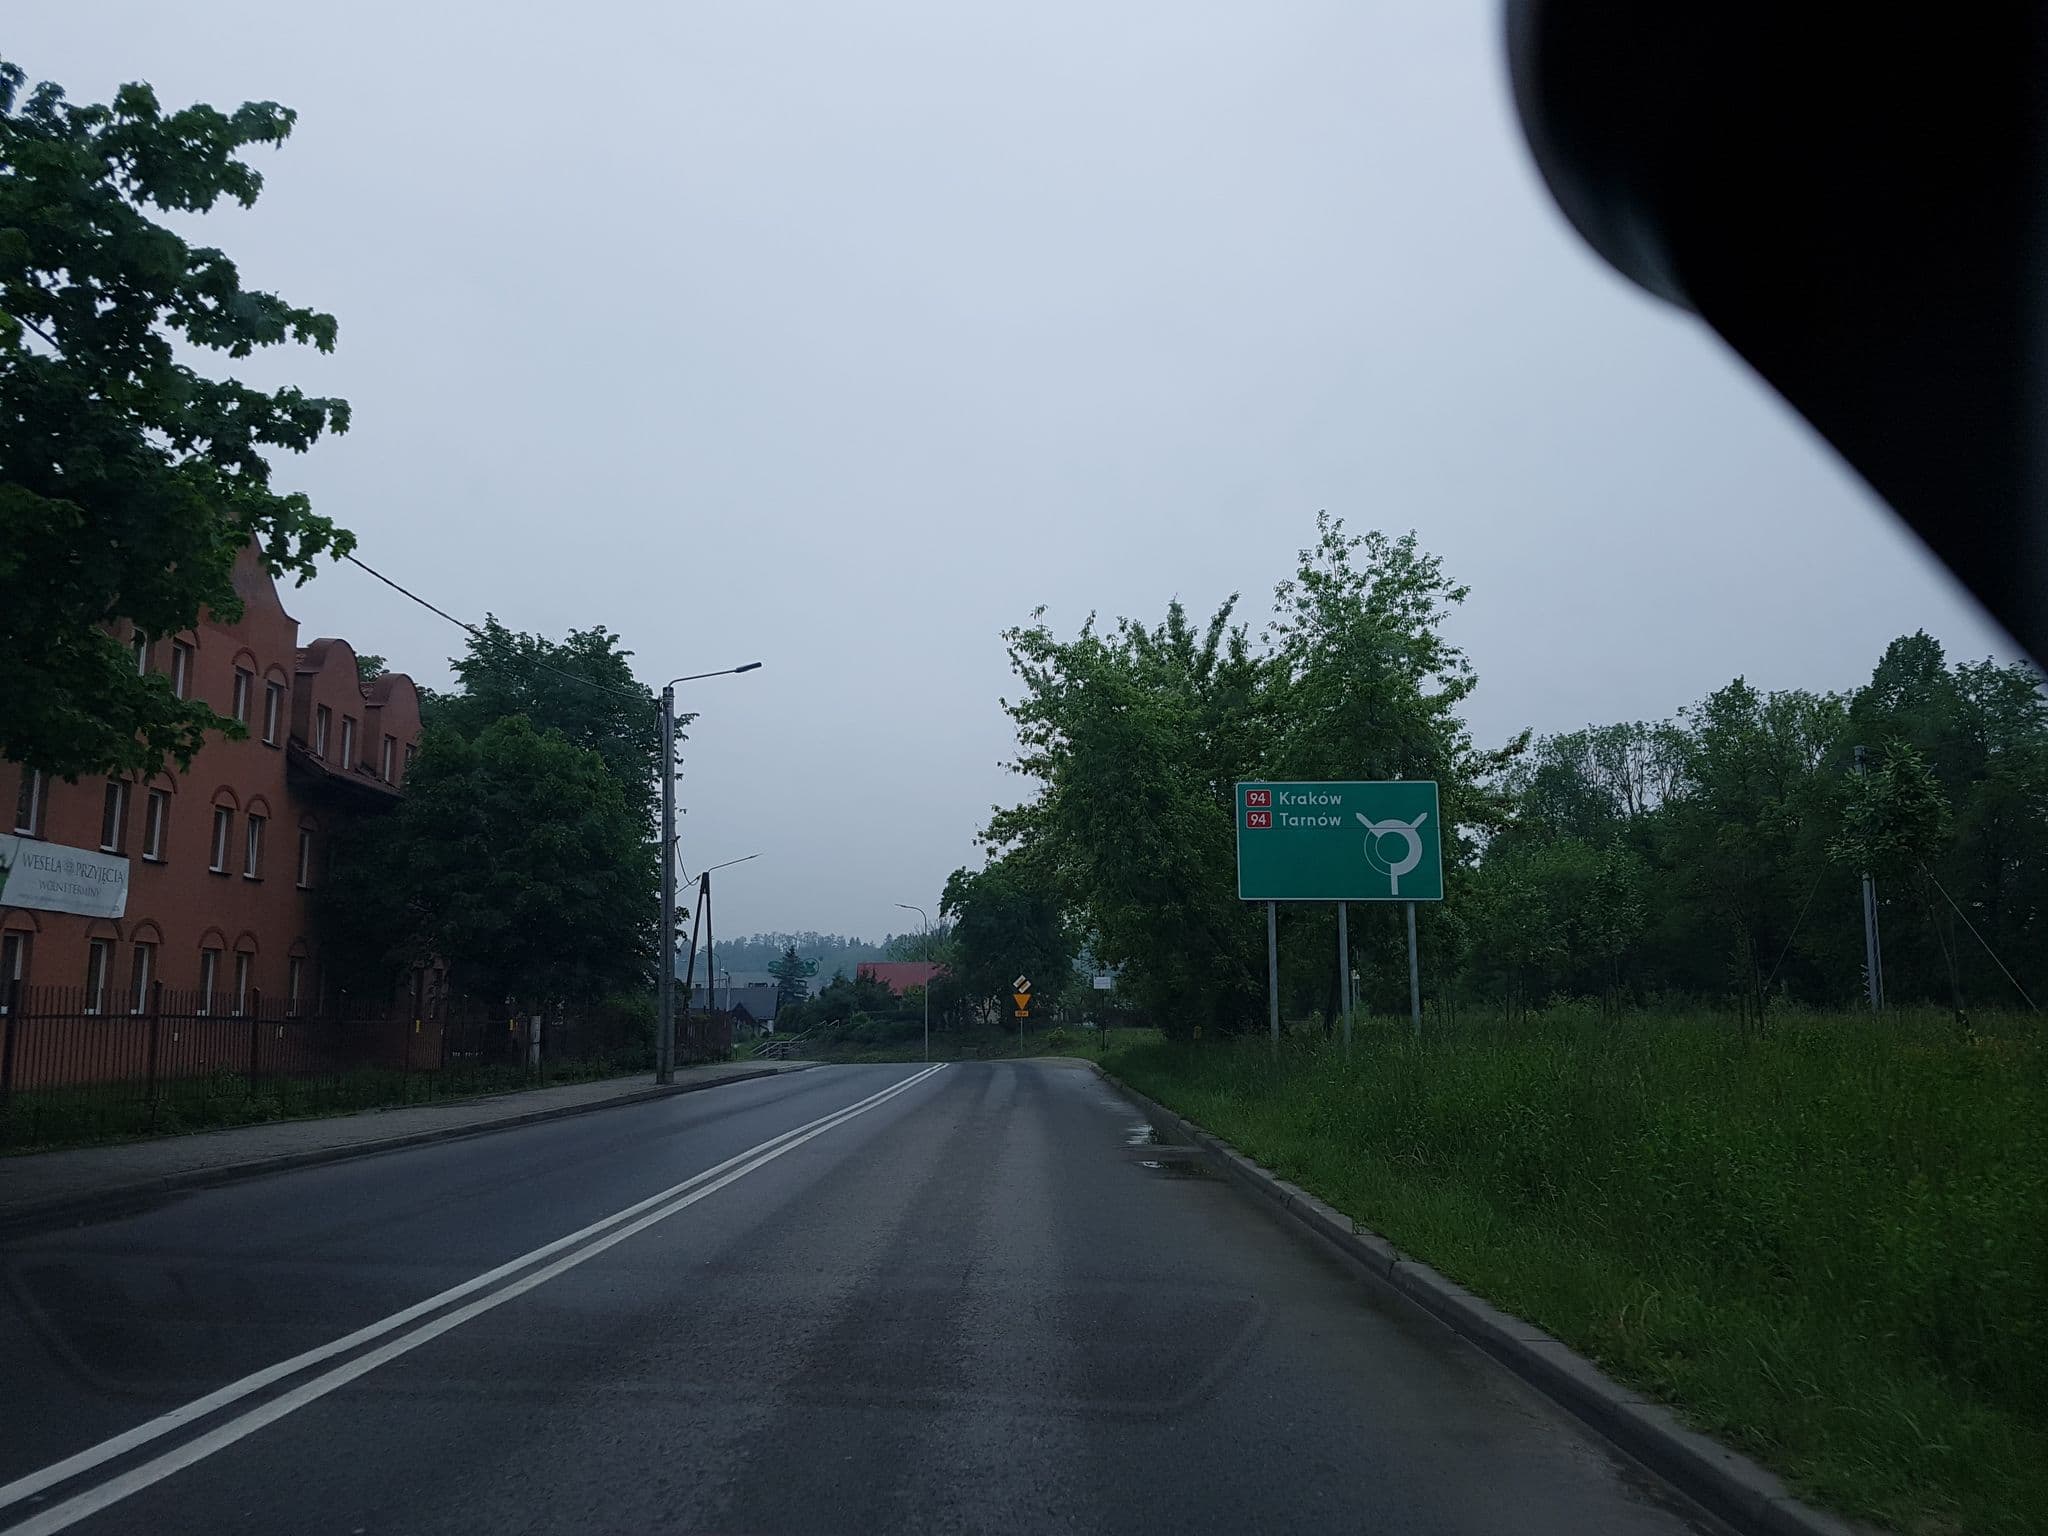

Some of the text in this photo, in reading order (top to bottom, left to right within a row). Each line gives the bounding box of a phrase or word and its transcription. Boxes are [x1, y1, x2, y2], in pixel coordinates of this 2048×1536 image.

[1250, 791, 1342, 805] 94 Kraków
[1250, 812, 1342, 826] 94 Tarnów
[23, 853, 124, 885] WESELA PRZYJĘCIA
